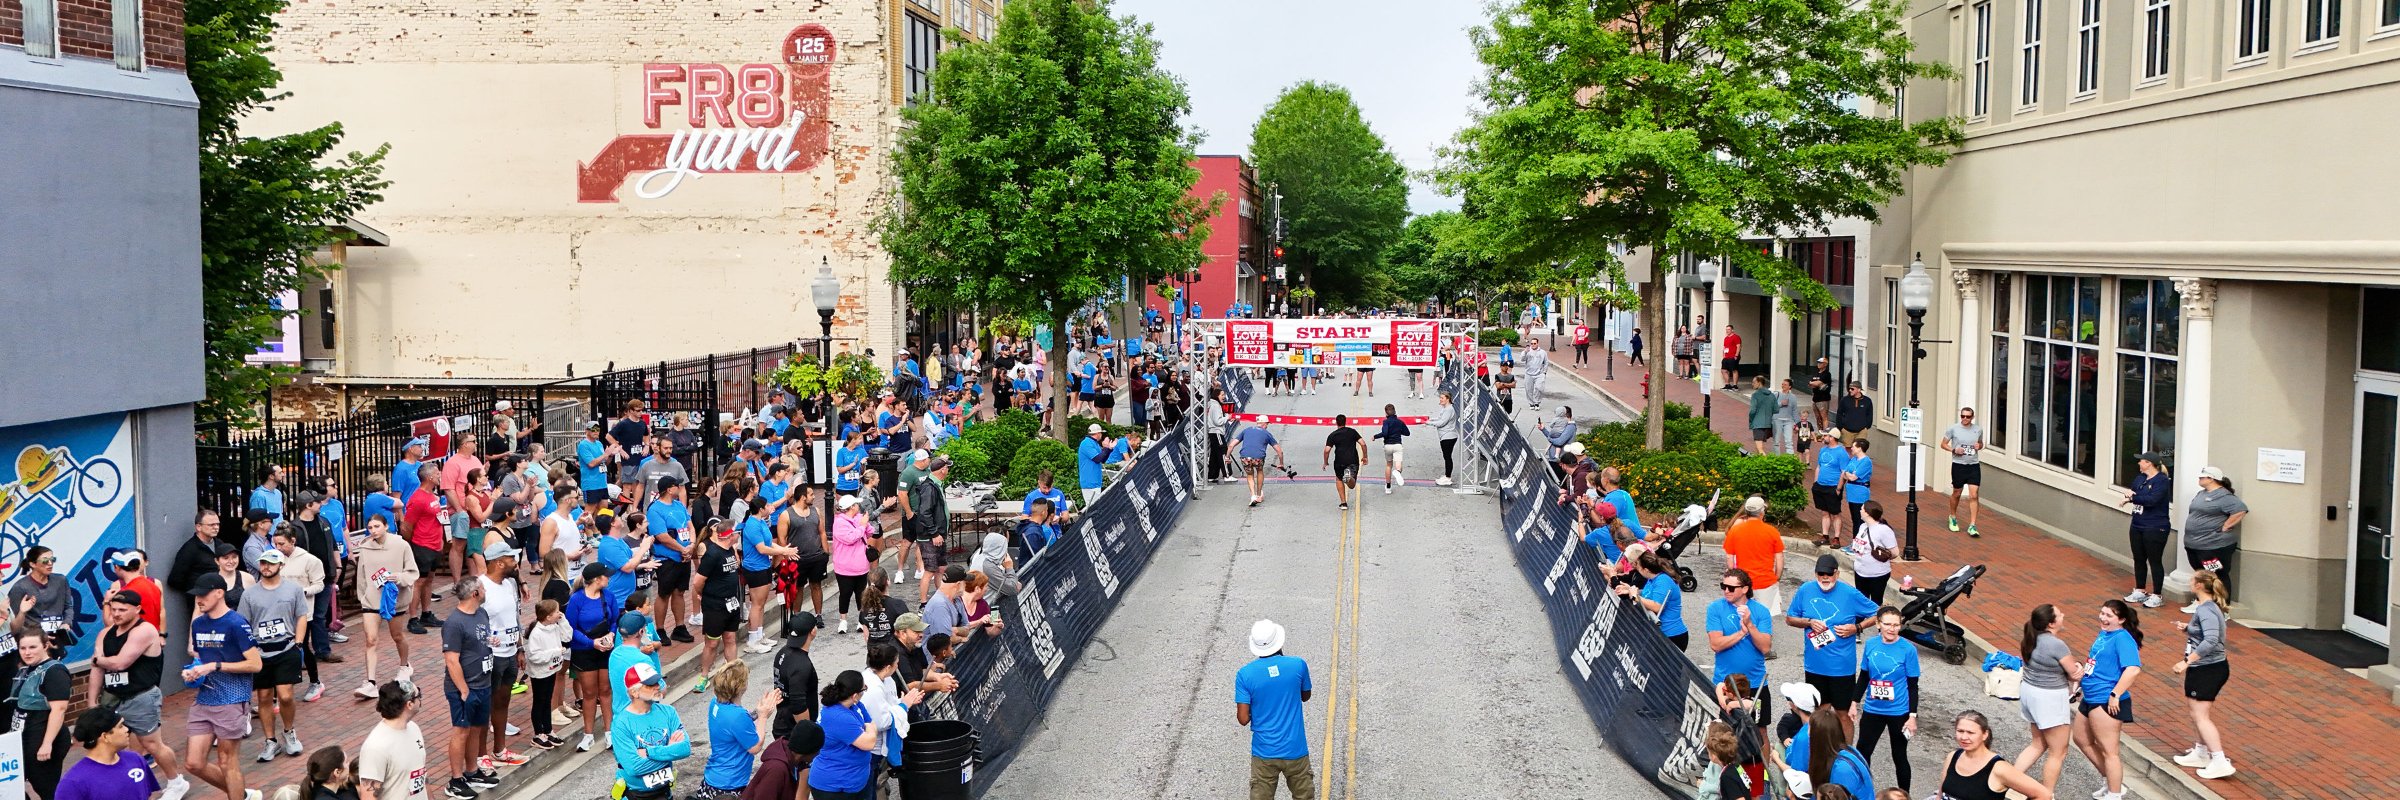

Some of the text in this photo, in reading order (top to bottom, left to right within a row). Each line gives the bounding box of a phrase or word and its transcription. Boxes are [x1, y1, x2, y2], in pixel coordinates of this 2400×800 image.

[794, 38, 825, 54] 125
[644, 63, 784, 128] FR8
[635, 110, 806, 199] yard
[1233, 332, 1268, 340] LOVE
[1297, 327, 1372, 339] START
[1397, 332, 1432, 341] LOVE
[1234, 345, 1268, 353] LIVE
[1397, 346, 1432, 355] LIVE
[1902, 410, 1907, 419] 2
[1084, 527, 1103, 564] RUN
[1094, 552, 1113, 588] GSP
[1020, 588, 1045, 638] RUN
[1593, 592, 1618, 640] RUN
[49, 622, 58, 630] 73
[266, 626, 278, 635] 55
[1, 639, 13, 650] 103
[1031, 620, 1056, 666] GSP
[1579, 622, 1606, 665] GSP
[1814, 634, 1830, 646] 336
[110, 674, 121, 683] 70
[972, 640, 1016, 714] MassMutual
[1872, 686, 1890, 698] 335
[648, 770, 669, 783] 212
